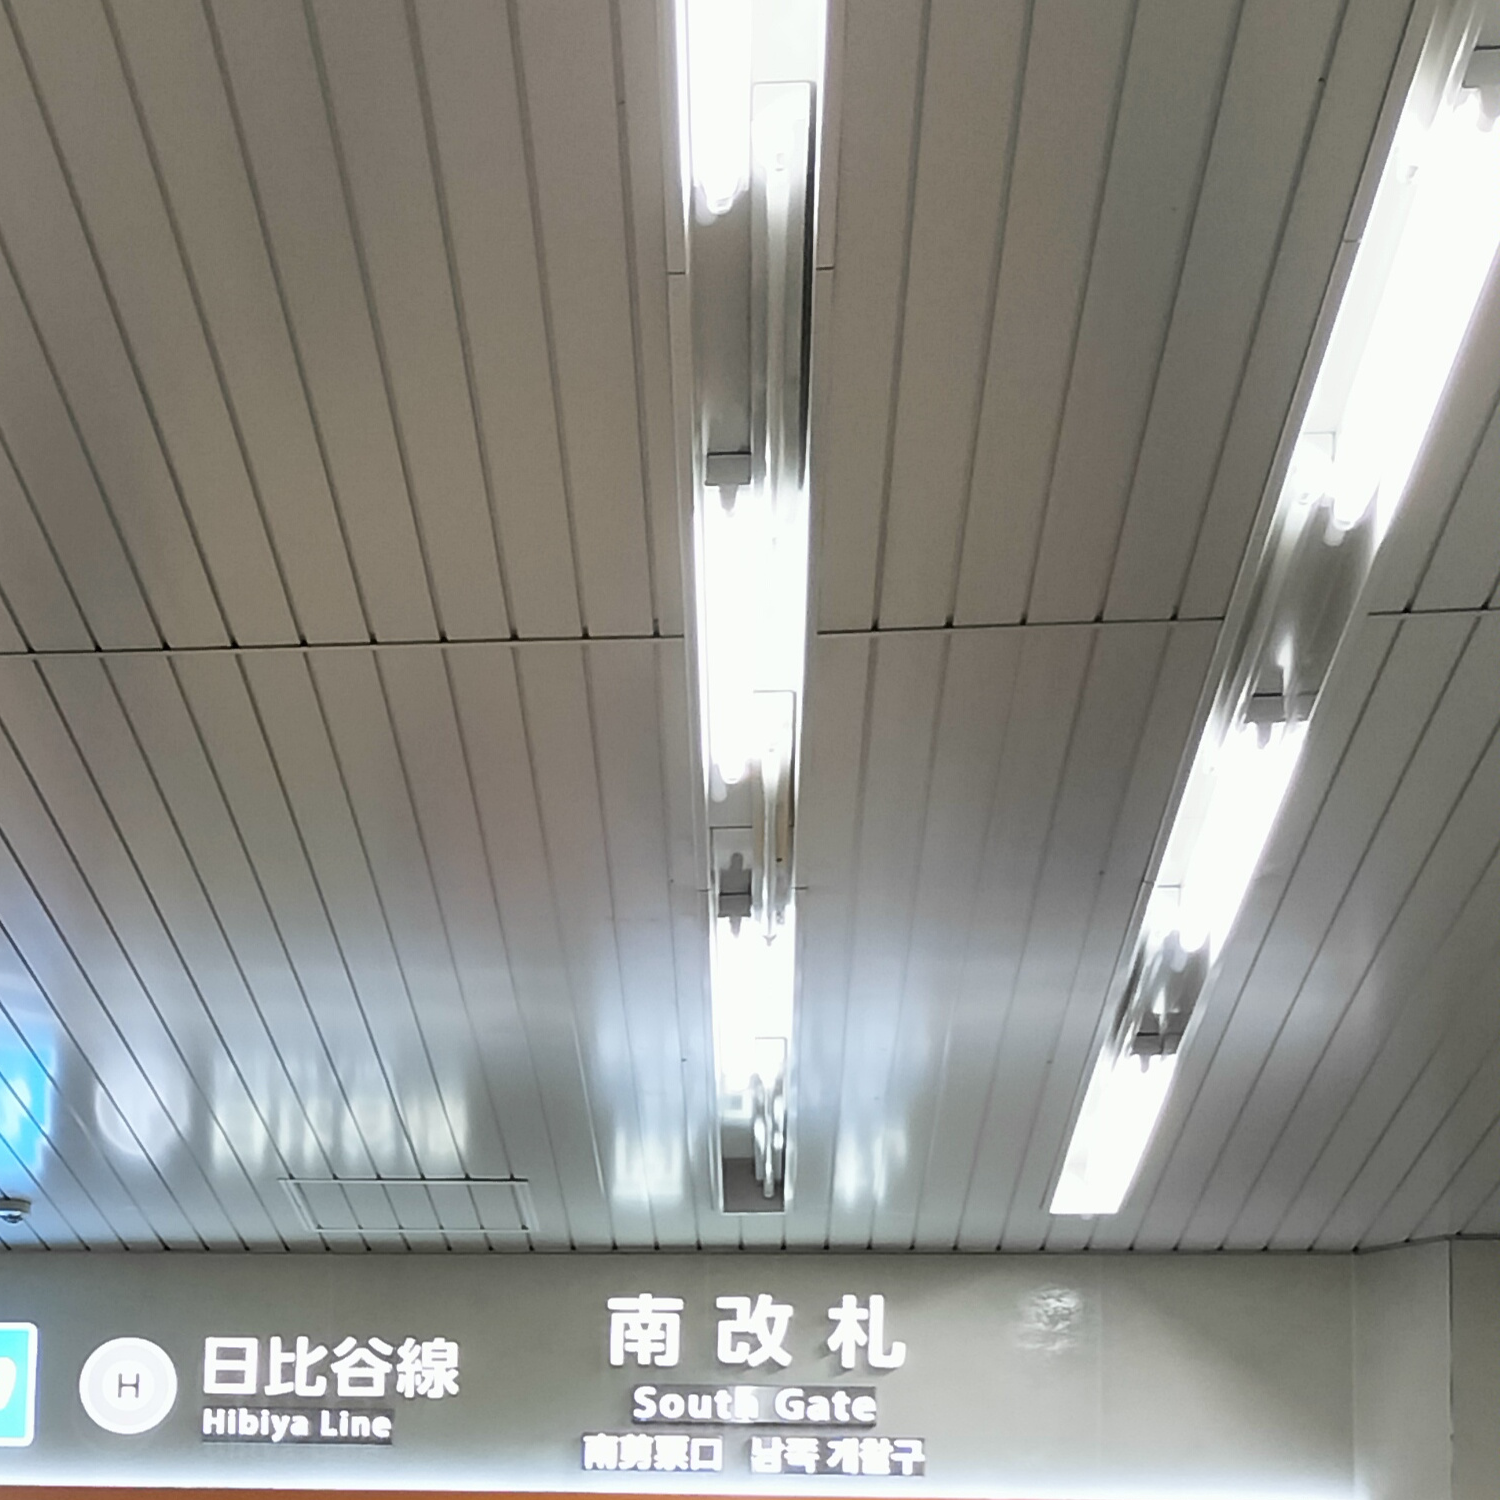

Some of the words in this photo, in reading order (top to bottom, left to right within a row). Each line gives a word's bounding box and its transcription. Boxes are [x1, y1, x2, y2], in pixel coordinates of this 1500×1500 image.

[606, 1292, 908, 1369] 南改札
[116, 1372, 141, 1399] H
[202, 1335, 461, 1400] 日比谷線
[632, 1385, 760, 1422] South
[773, 1387, 878, 1422] Gate
[201, 1407, 309, 1441] Hibiya
[319, 1408, 393, 1439] Line
